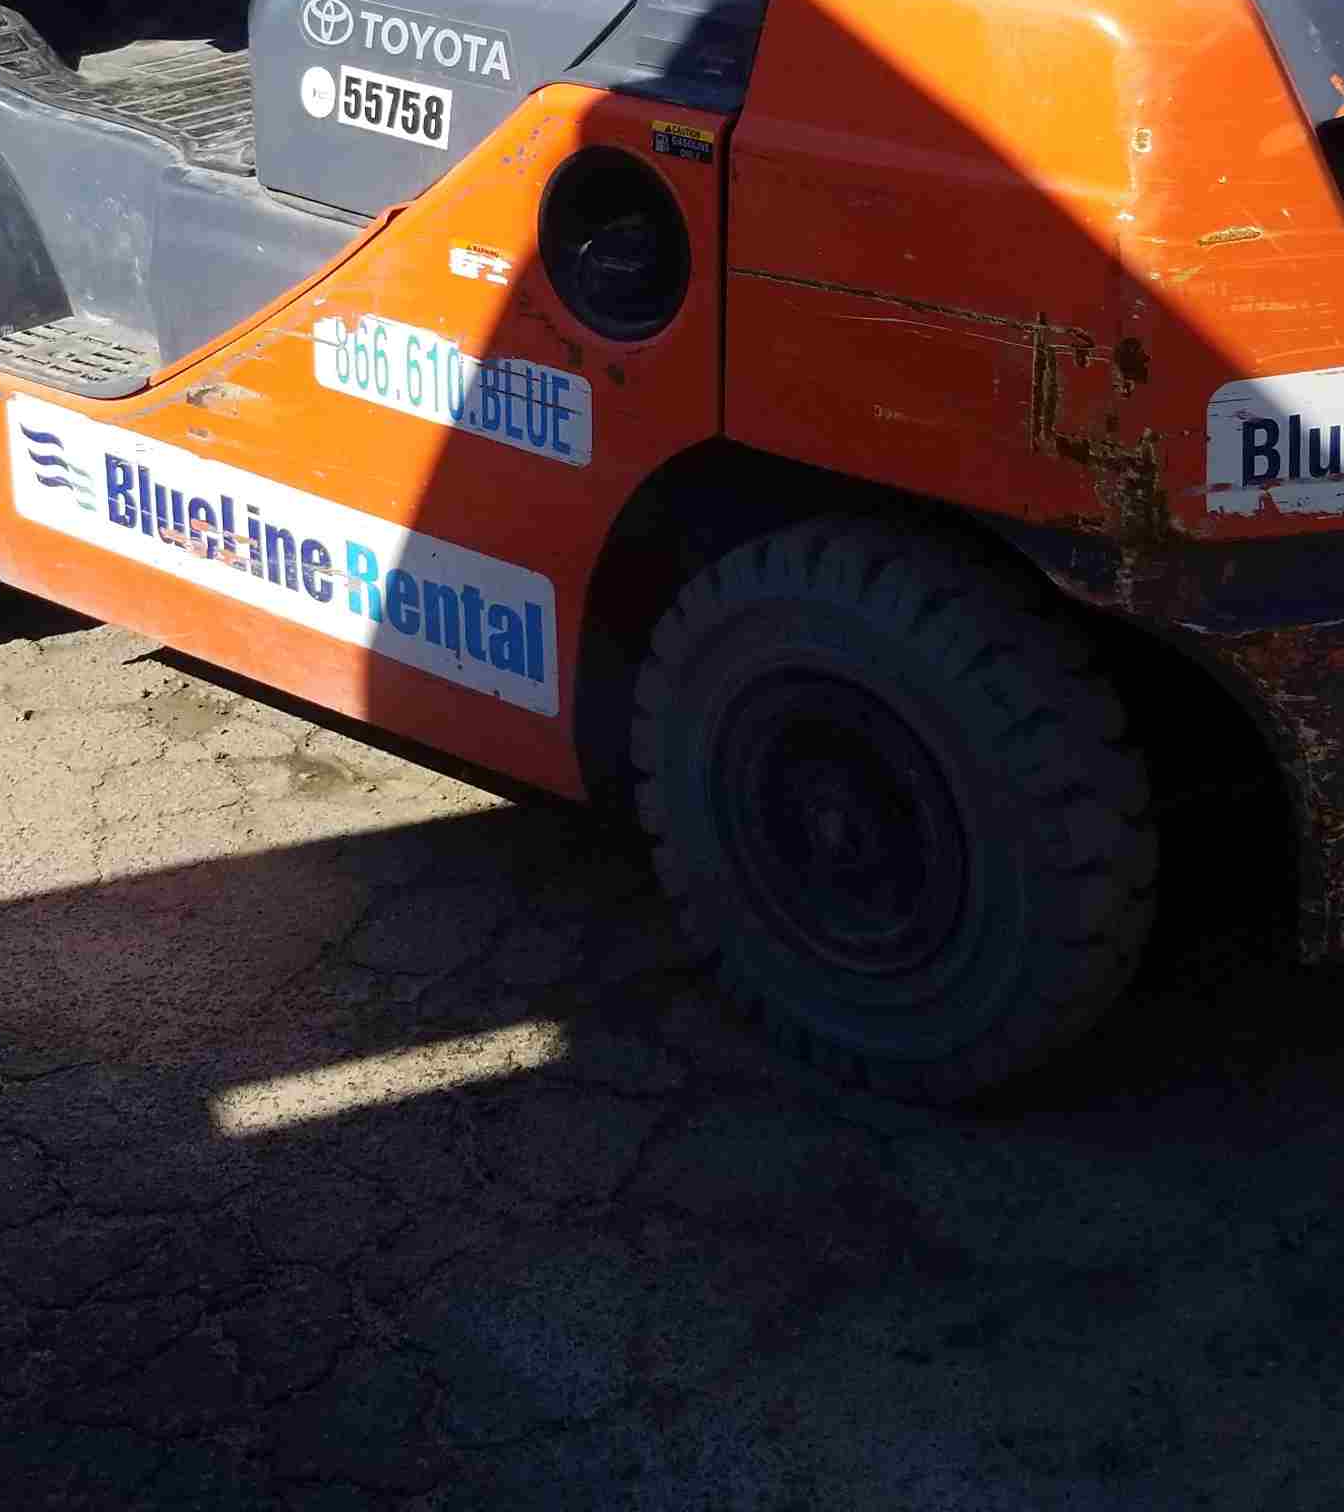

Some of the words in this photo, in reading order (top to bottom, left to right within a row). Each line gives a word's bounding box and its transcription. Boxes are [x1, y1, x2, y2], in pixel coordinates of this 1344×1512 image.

[360, 11, 512, 81] TOYOTA
[343, 75, 446, 141] 55758
[103, 452, 334, 604] BlueLine
[345, 540, 546, 684] Rental
